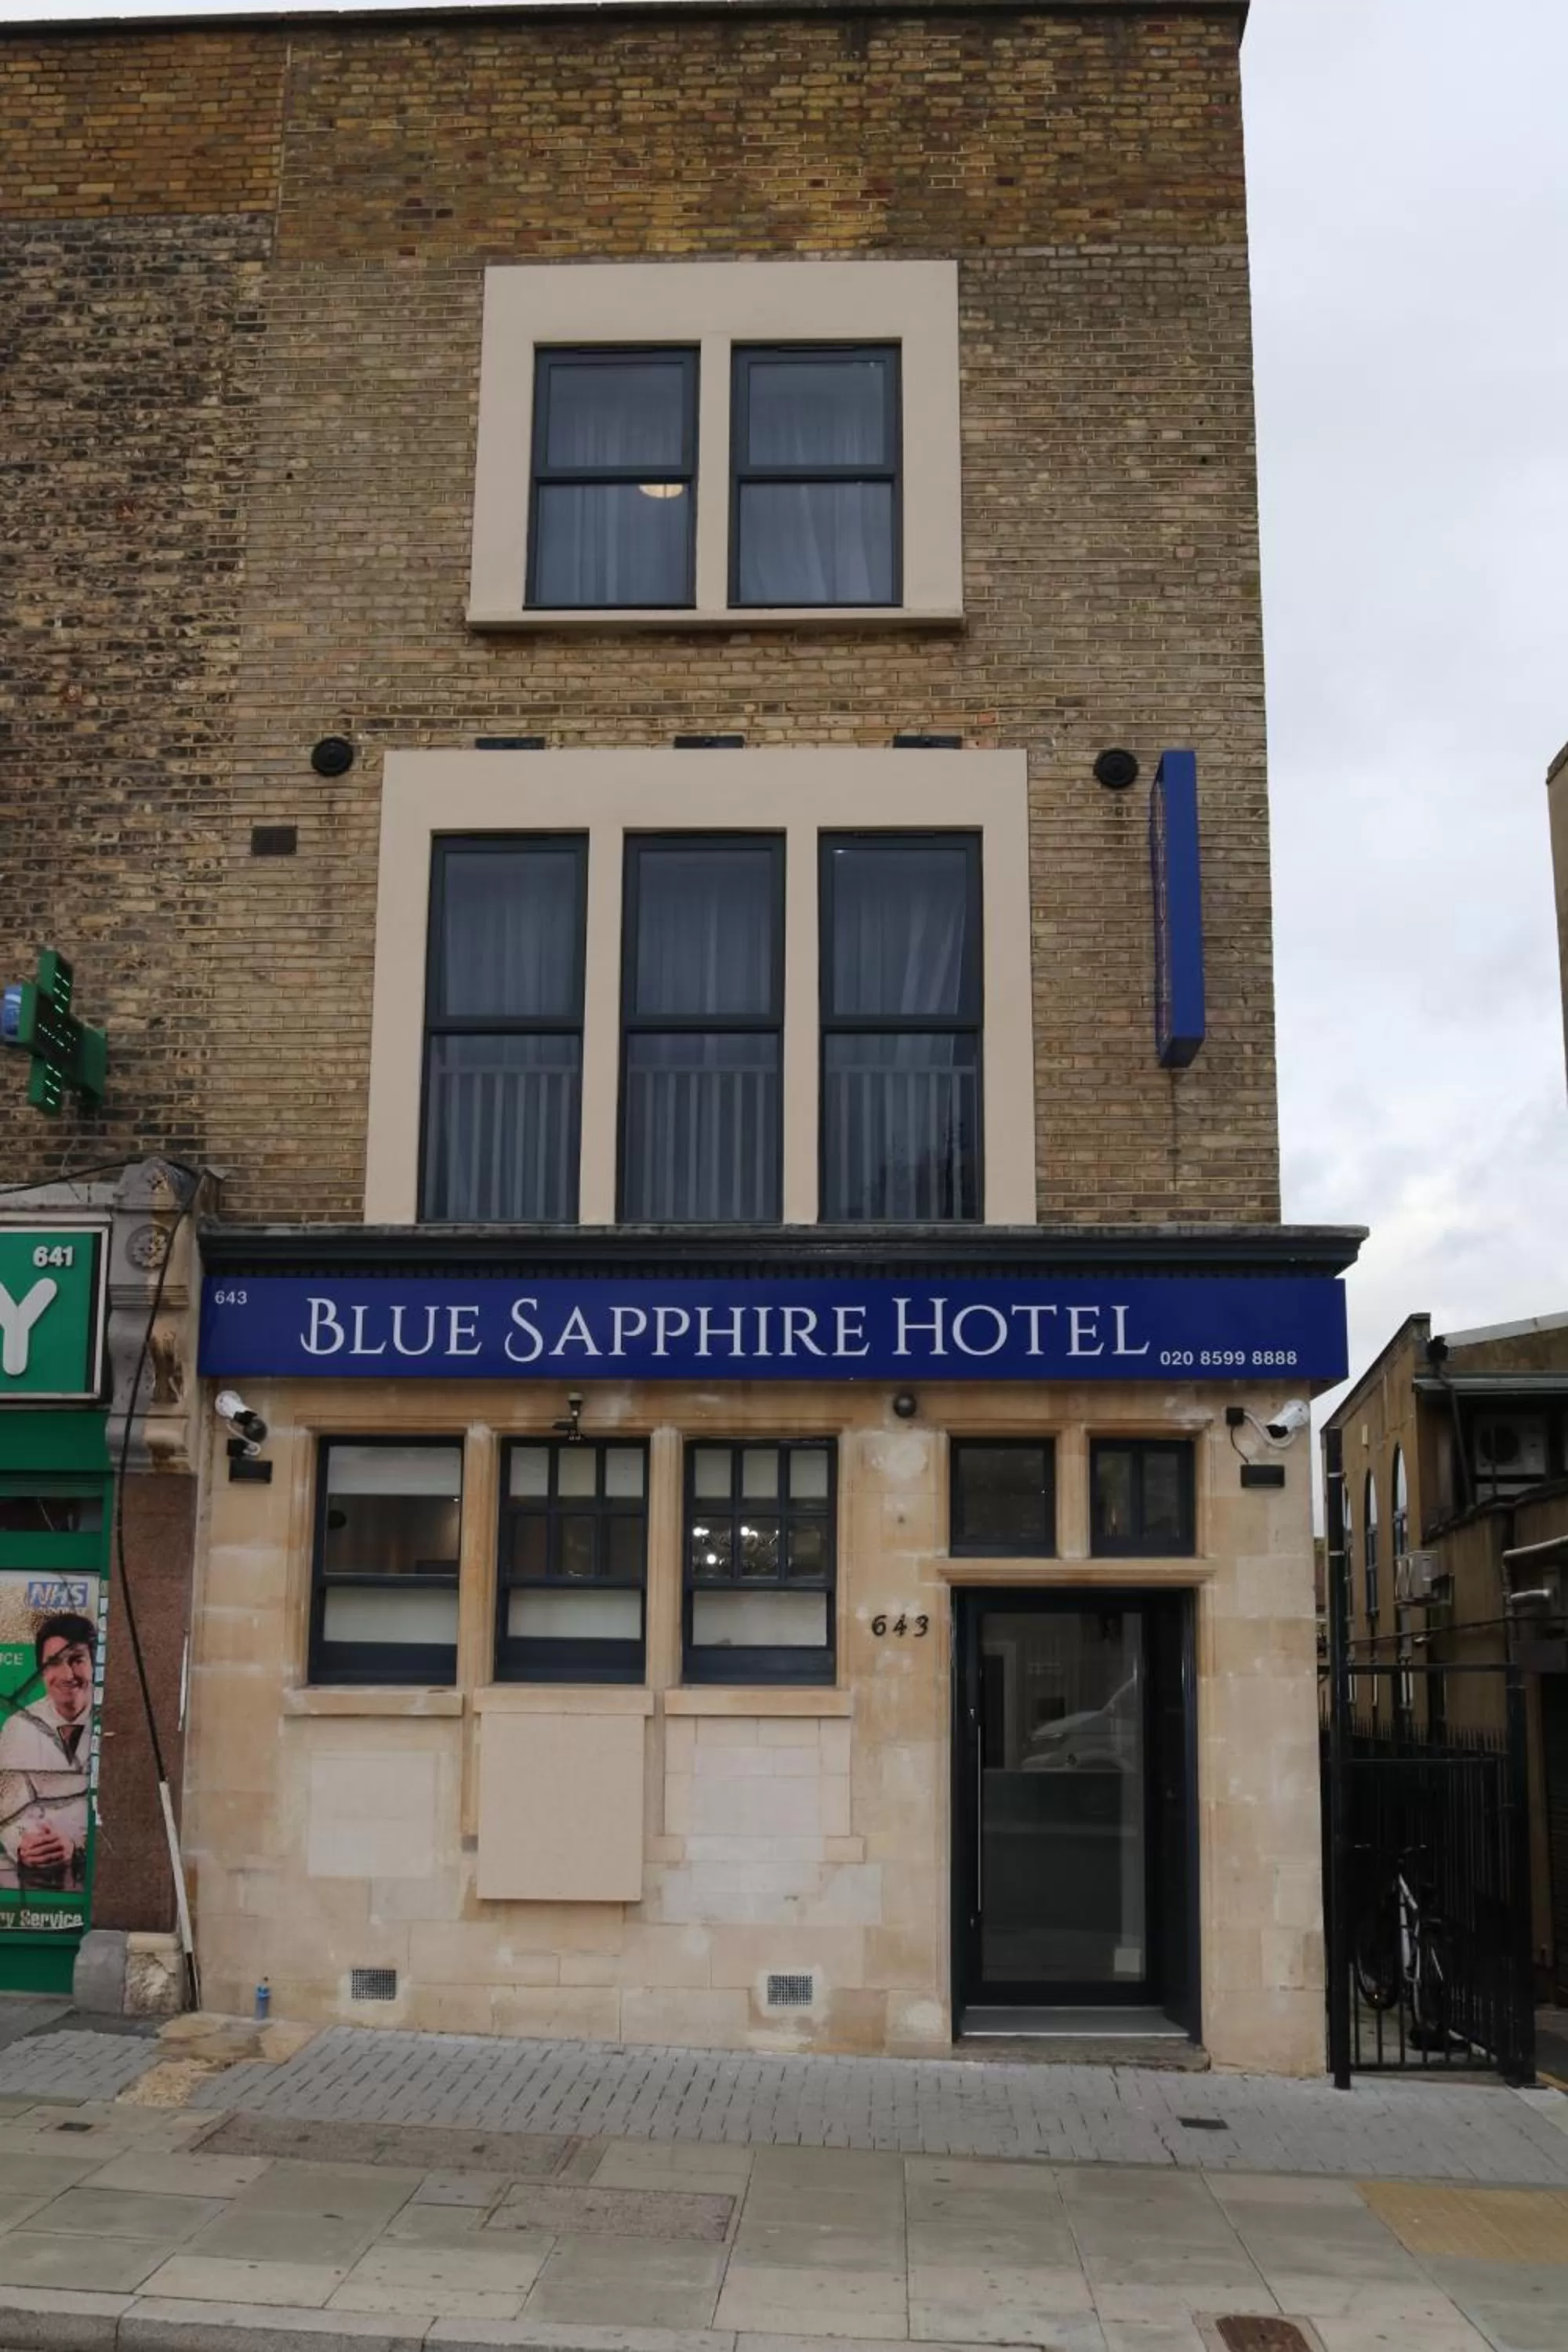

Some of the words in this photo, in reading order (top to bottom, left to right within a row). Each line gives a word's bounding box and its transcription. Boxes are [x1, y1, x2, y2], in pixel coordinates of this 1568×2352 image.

[33, 1246, 73, 1268] 641
[215, 1291, 248, 1305] 643
[0, 1277, 57, 1376] Y
[300, 1298, 482, 1356] BLUE
[504, 1298, 870, 1363] SAPPHIRE
[892, 1298, 1151, 1356] HOTEL
[1160, 1351, 1194, 1366] 020
[1200, 1351, 1246, 1366] 8599
[1252, 1351, 1298, 1366] 8888
[30, 1583, 85, 1606] NHS
[870, 1613, 928, 1638] 643
[20, 1910, 83, 1926] Service
